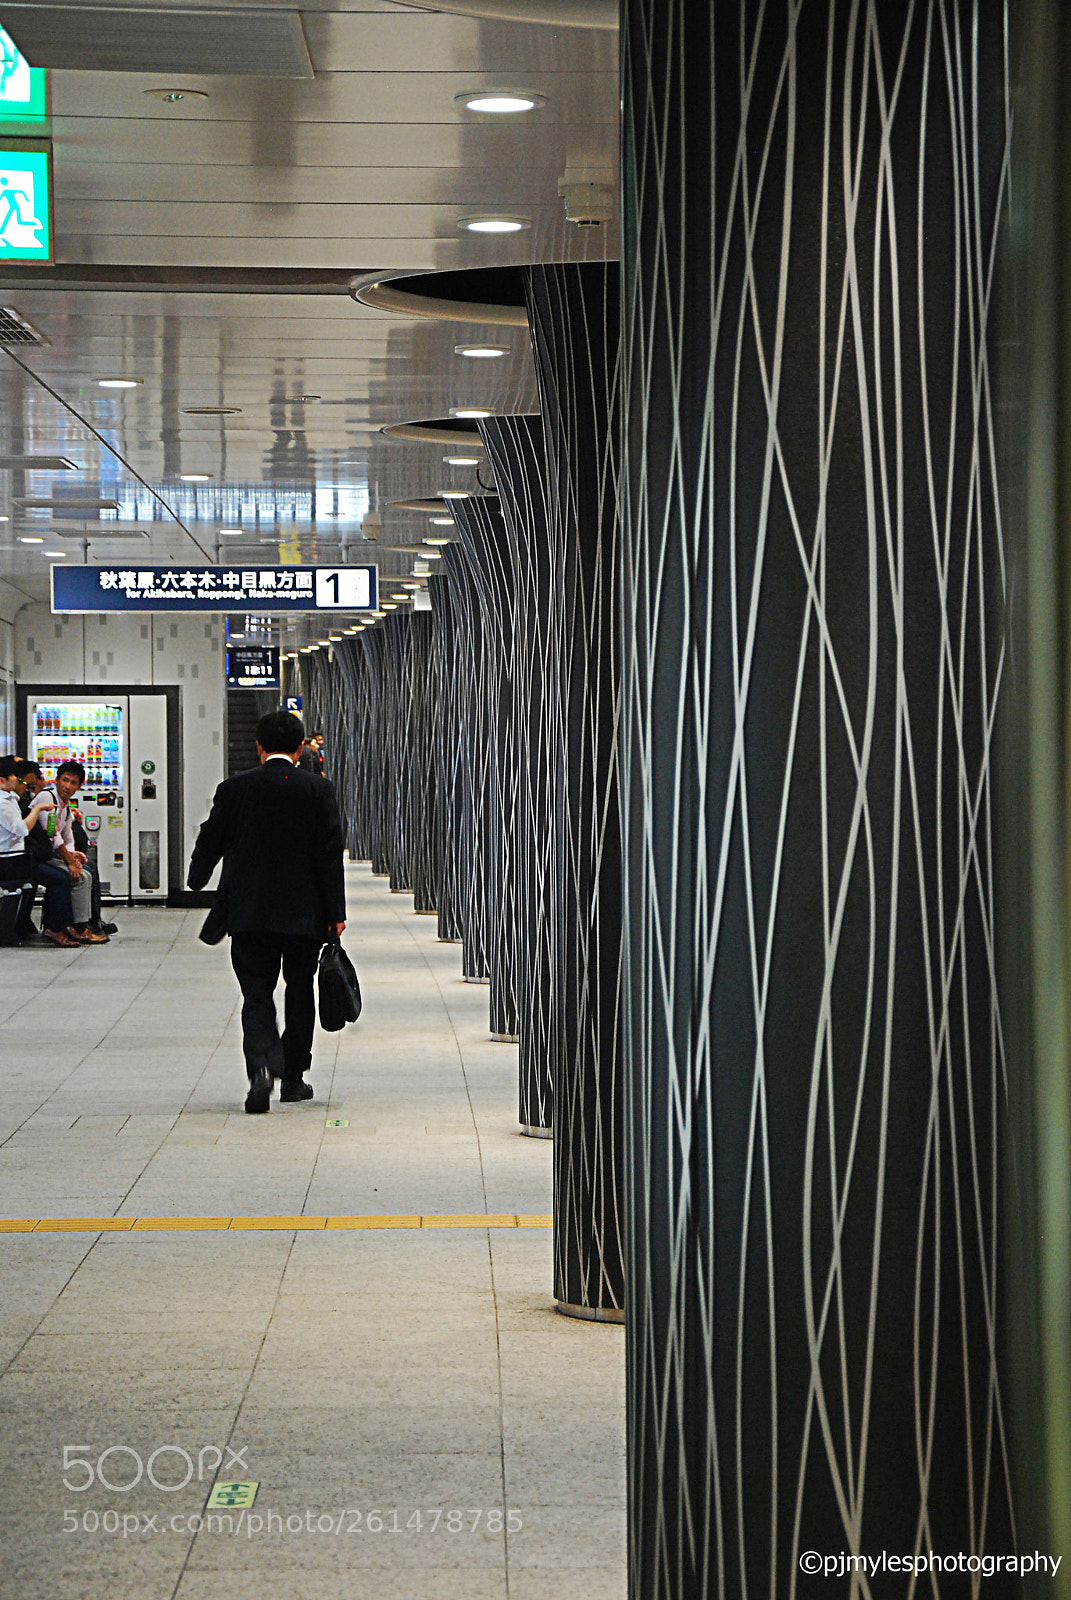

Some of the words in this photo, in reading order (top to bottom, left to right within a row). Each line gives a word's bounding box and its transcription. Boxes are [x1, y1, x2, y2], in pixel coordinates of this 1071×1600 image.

[125, 588, 141, 598] for
[197, 588, 247, 600] Roppongi,
[248, 588, 314, 600] Naka-meguro
[325, 572, 339, 604] 1
[265, 650, 272, 664] 1
